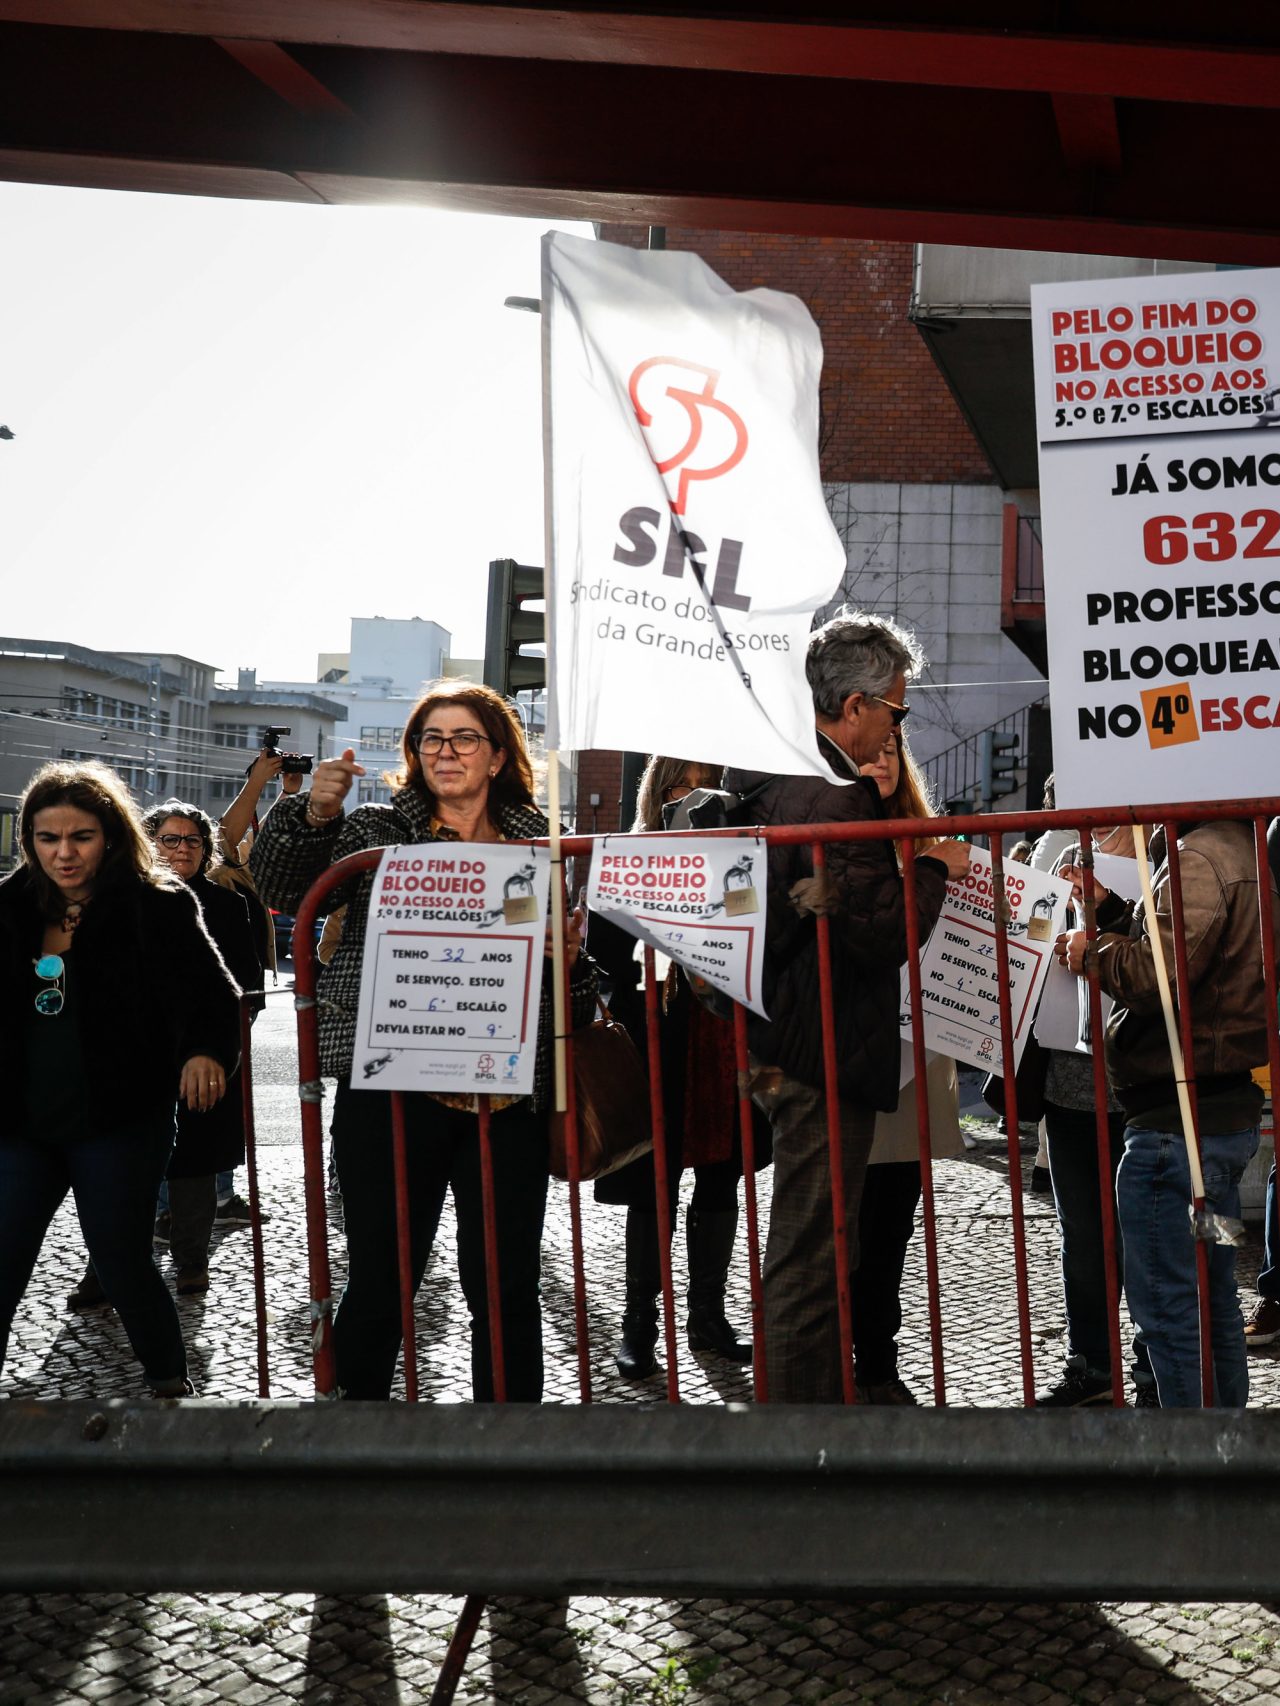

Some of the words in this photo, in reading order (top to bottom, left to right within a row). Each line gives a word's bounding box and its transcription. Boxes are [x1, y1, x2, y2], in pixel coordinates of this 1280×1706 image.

[1052, 307, 1133, 336] PELO
[1142, 302, 1197, 329] FIM
[1206, 299, 1256, 325] DO
[1055, 331, 1262, 373] BLOQUEIO
[1056, 380, 1096, 402] NO
[1104, 373, 1204, 399] ACESSO
[1211, 368, 1266, 392] AOS
[1093, 407, 1105, 424] e
[1147, 393, 1264, 420] ESCALÕES
[1111, 454, 1159, 495] JÁ
[571, 578, 667, 612] Sndicato
[597, 617, 626, 641] da
[636, 624, 725, 662] Grande
[1078, 704, 1141, 740] NO
[1151, 695, 1190, 735] 4º
[386, 859, 423, 872] PELO
[427, 860, 455, 873] FIM
[459, 861, 485, 874] DO
[602, 855, 643, 869] PELO
[647, 856, 675, 868] FIM
[680, 856, 704, 868] DO
[382, 876, 486, 894] BLOQUEIO
[600, 871, 706, 888] BLOQUEIO
[1006, 876, 1025, 890] DO
[598, 885, 618, 895] NO
[622, 889, 675, 902] ACESSO
[678, 892, 706, 903] AOS
[944, 885, 959, 896] NO
[380, 895, 399, 906] NO
[402, 896, 453, 908] ACESSO
[457, 898, 485, 909] AOS
[643, 901, 703, 914] ESCALÕES
[423, 910, 482, 922] ESCALÕES
[702, 940, 733, 950] ANOS
[944, 931, 970, 947] TENHO
[1008, 957, 1026, 971] NOS
[392, 949, 428, 959] TENHO
[440, 948, 465, 963] 32
[481, 953, 512, 963] ANOS
[692, 953, 726, 967] ESTOU
[941, 953, 952, 963] DE
[952, 957, 988, 977] SERVIÇO.
[396, 975, 409, 984] DE
[412, 975, 464, 988] SERVIÇO.
[469, 978, 504, 987] ESTOU
[930, 970, 944, 981] NO
[978, 989, 1001, 1005] ESCAL
[389, 1000, 406, 1009] NO
[457, 1001, 507, 1012] ESCALÃO
[920, 989, 940, 1003] EVIA
[941, 997, 966, 1013] ESTAR
[966, 1004, 980, 1017] NO
[376, 1023, 411, 1034] DEVIA
[413, 1024, 445, 1036] ESTAR
[448, 1026, 465, 1036] NO
[977, 1050, 993, 1061] SPGL
